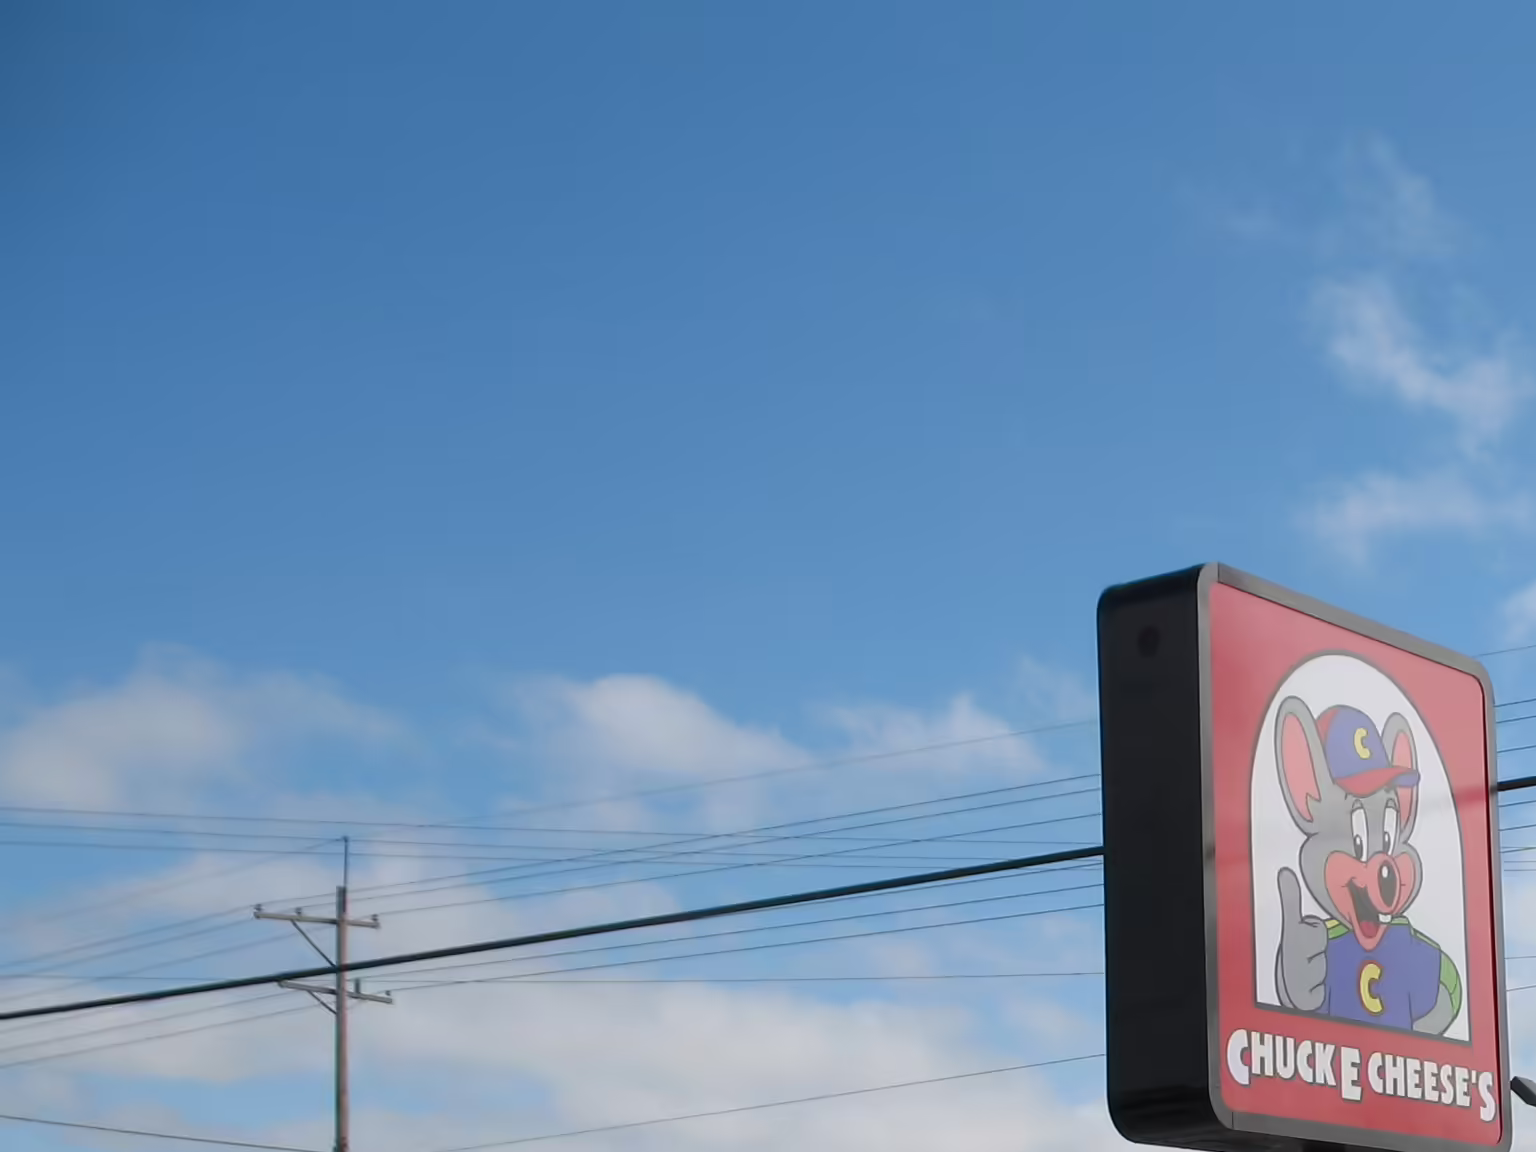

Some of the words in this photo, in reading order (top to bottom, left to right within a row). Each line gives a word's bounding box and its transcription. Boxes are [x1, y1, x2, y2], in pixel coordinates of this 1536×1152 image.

[1353, 727, 1372, 759] C
[1359, 961, 1385, 1014] C
[1226, 1028, 1337, 1086] CHUCK
[1340, 1046, 1363, 1101] E
[1367, 1052, 1497, 1122] CHEESE'S
